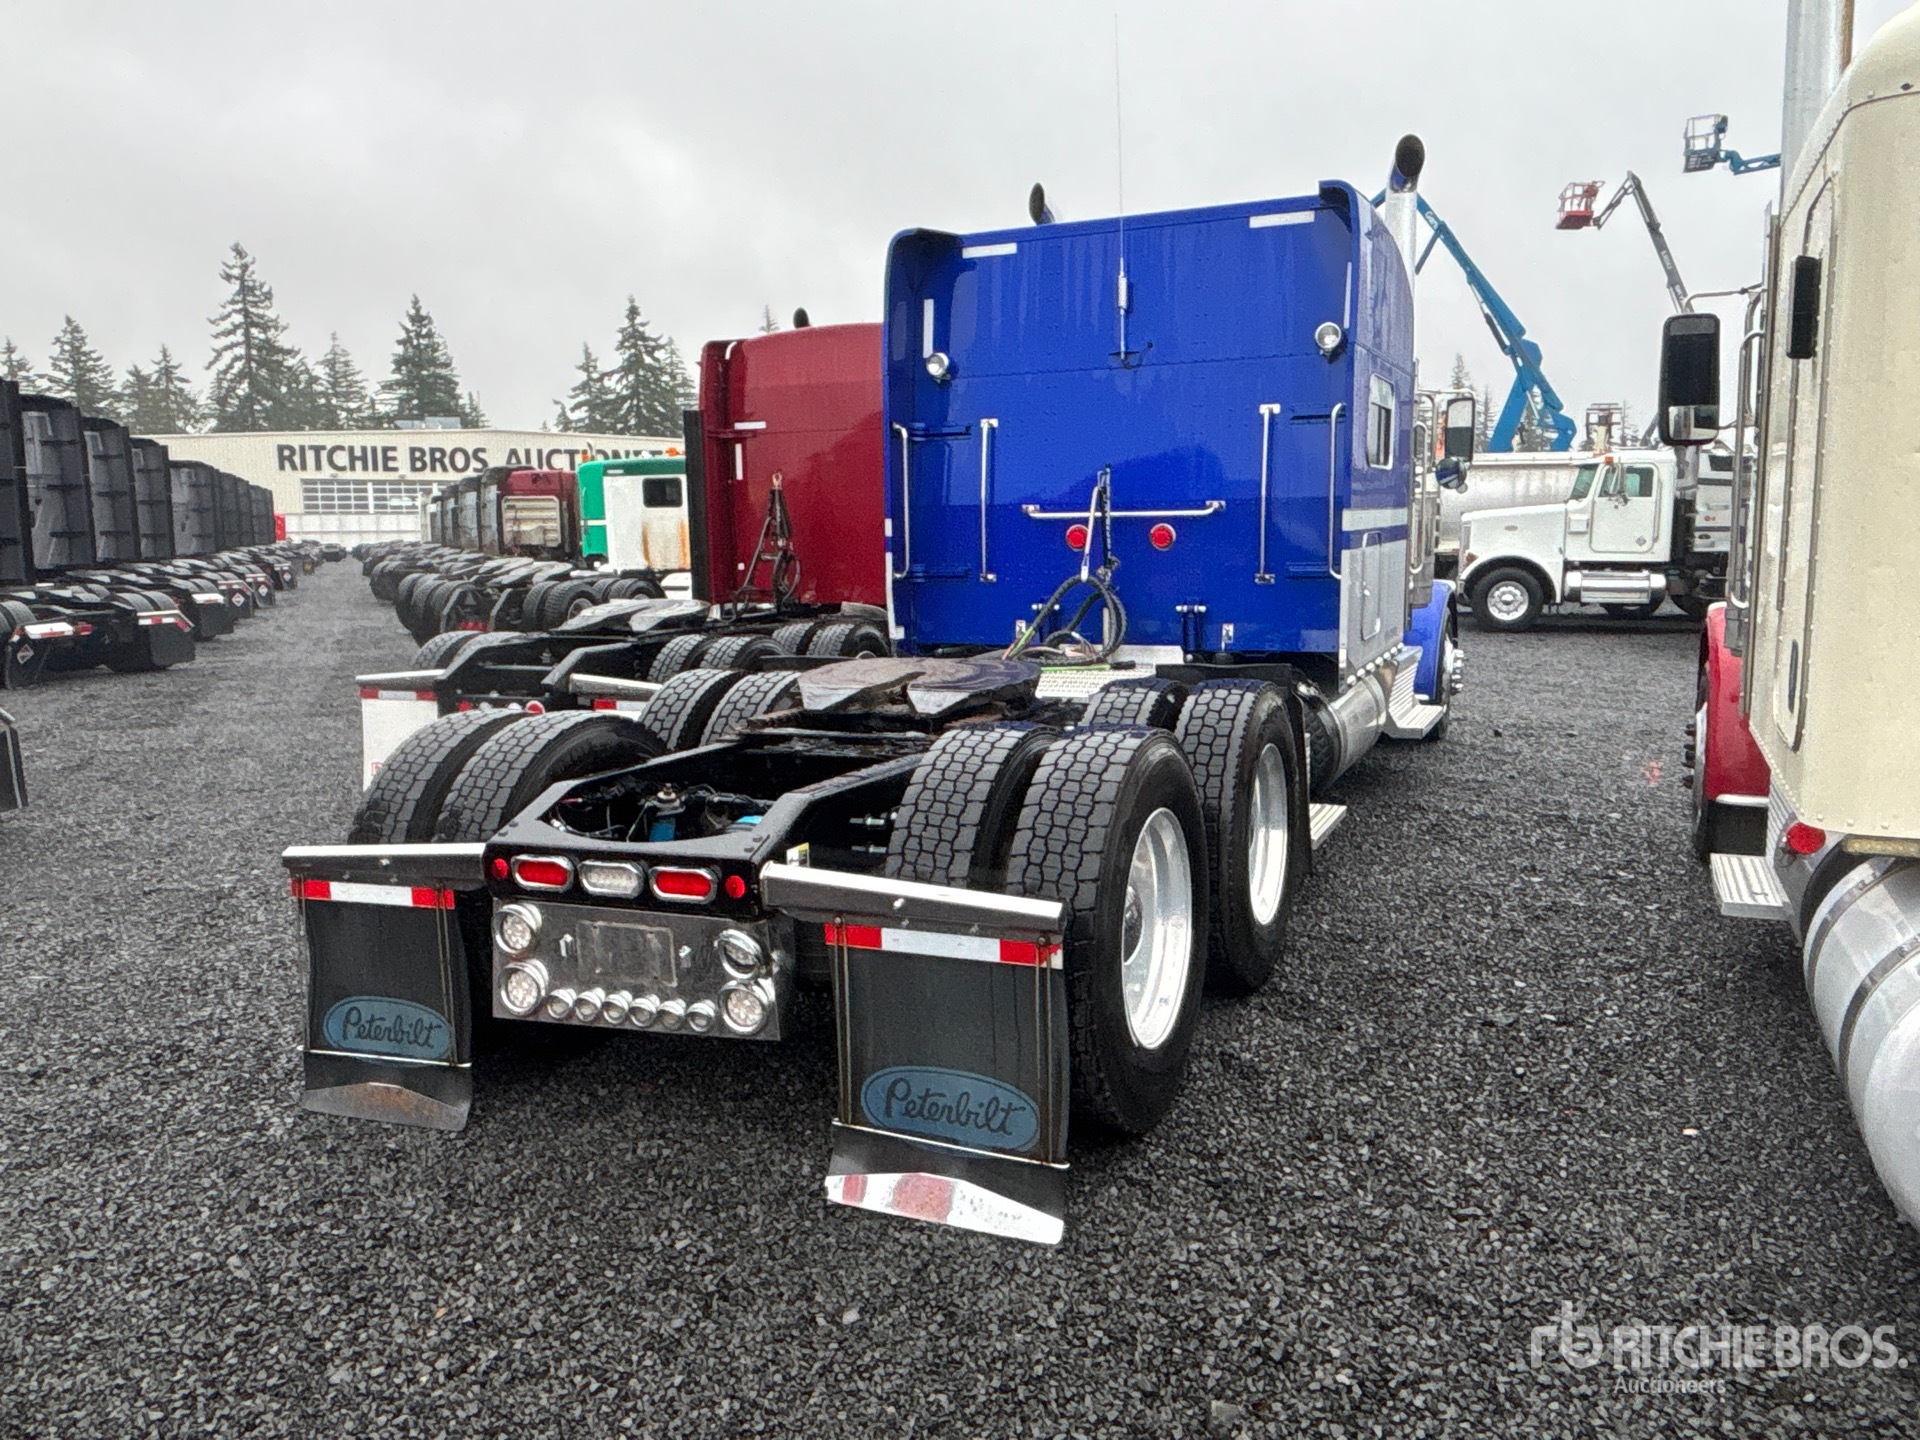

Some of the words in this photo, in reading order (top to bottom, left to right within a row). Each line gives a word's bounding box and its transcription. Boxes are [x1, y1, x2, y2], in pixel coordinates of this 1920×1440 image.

[277, 444, 399, 472] RITCHIE
[409, 446, 489, 473] BROS
[341, 1006, 442, 1048] Peterbilt
[884, 1077, 1026, 1136] Peterbilt
